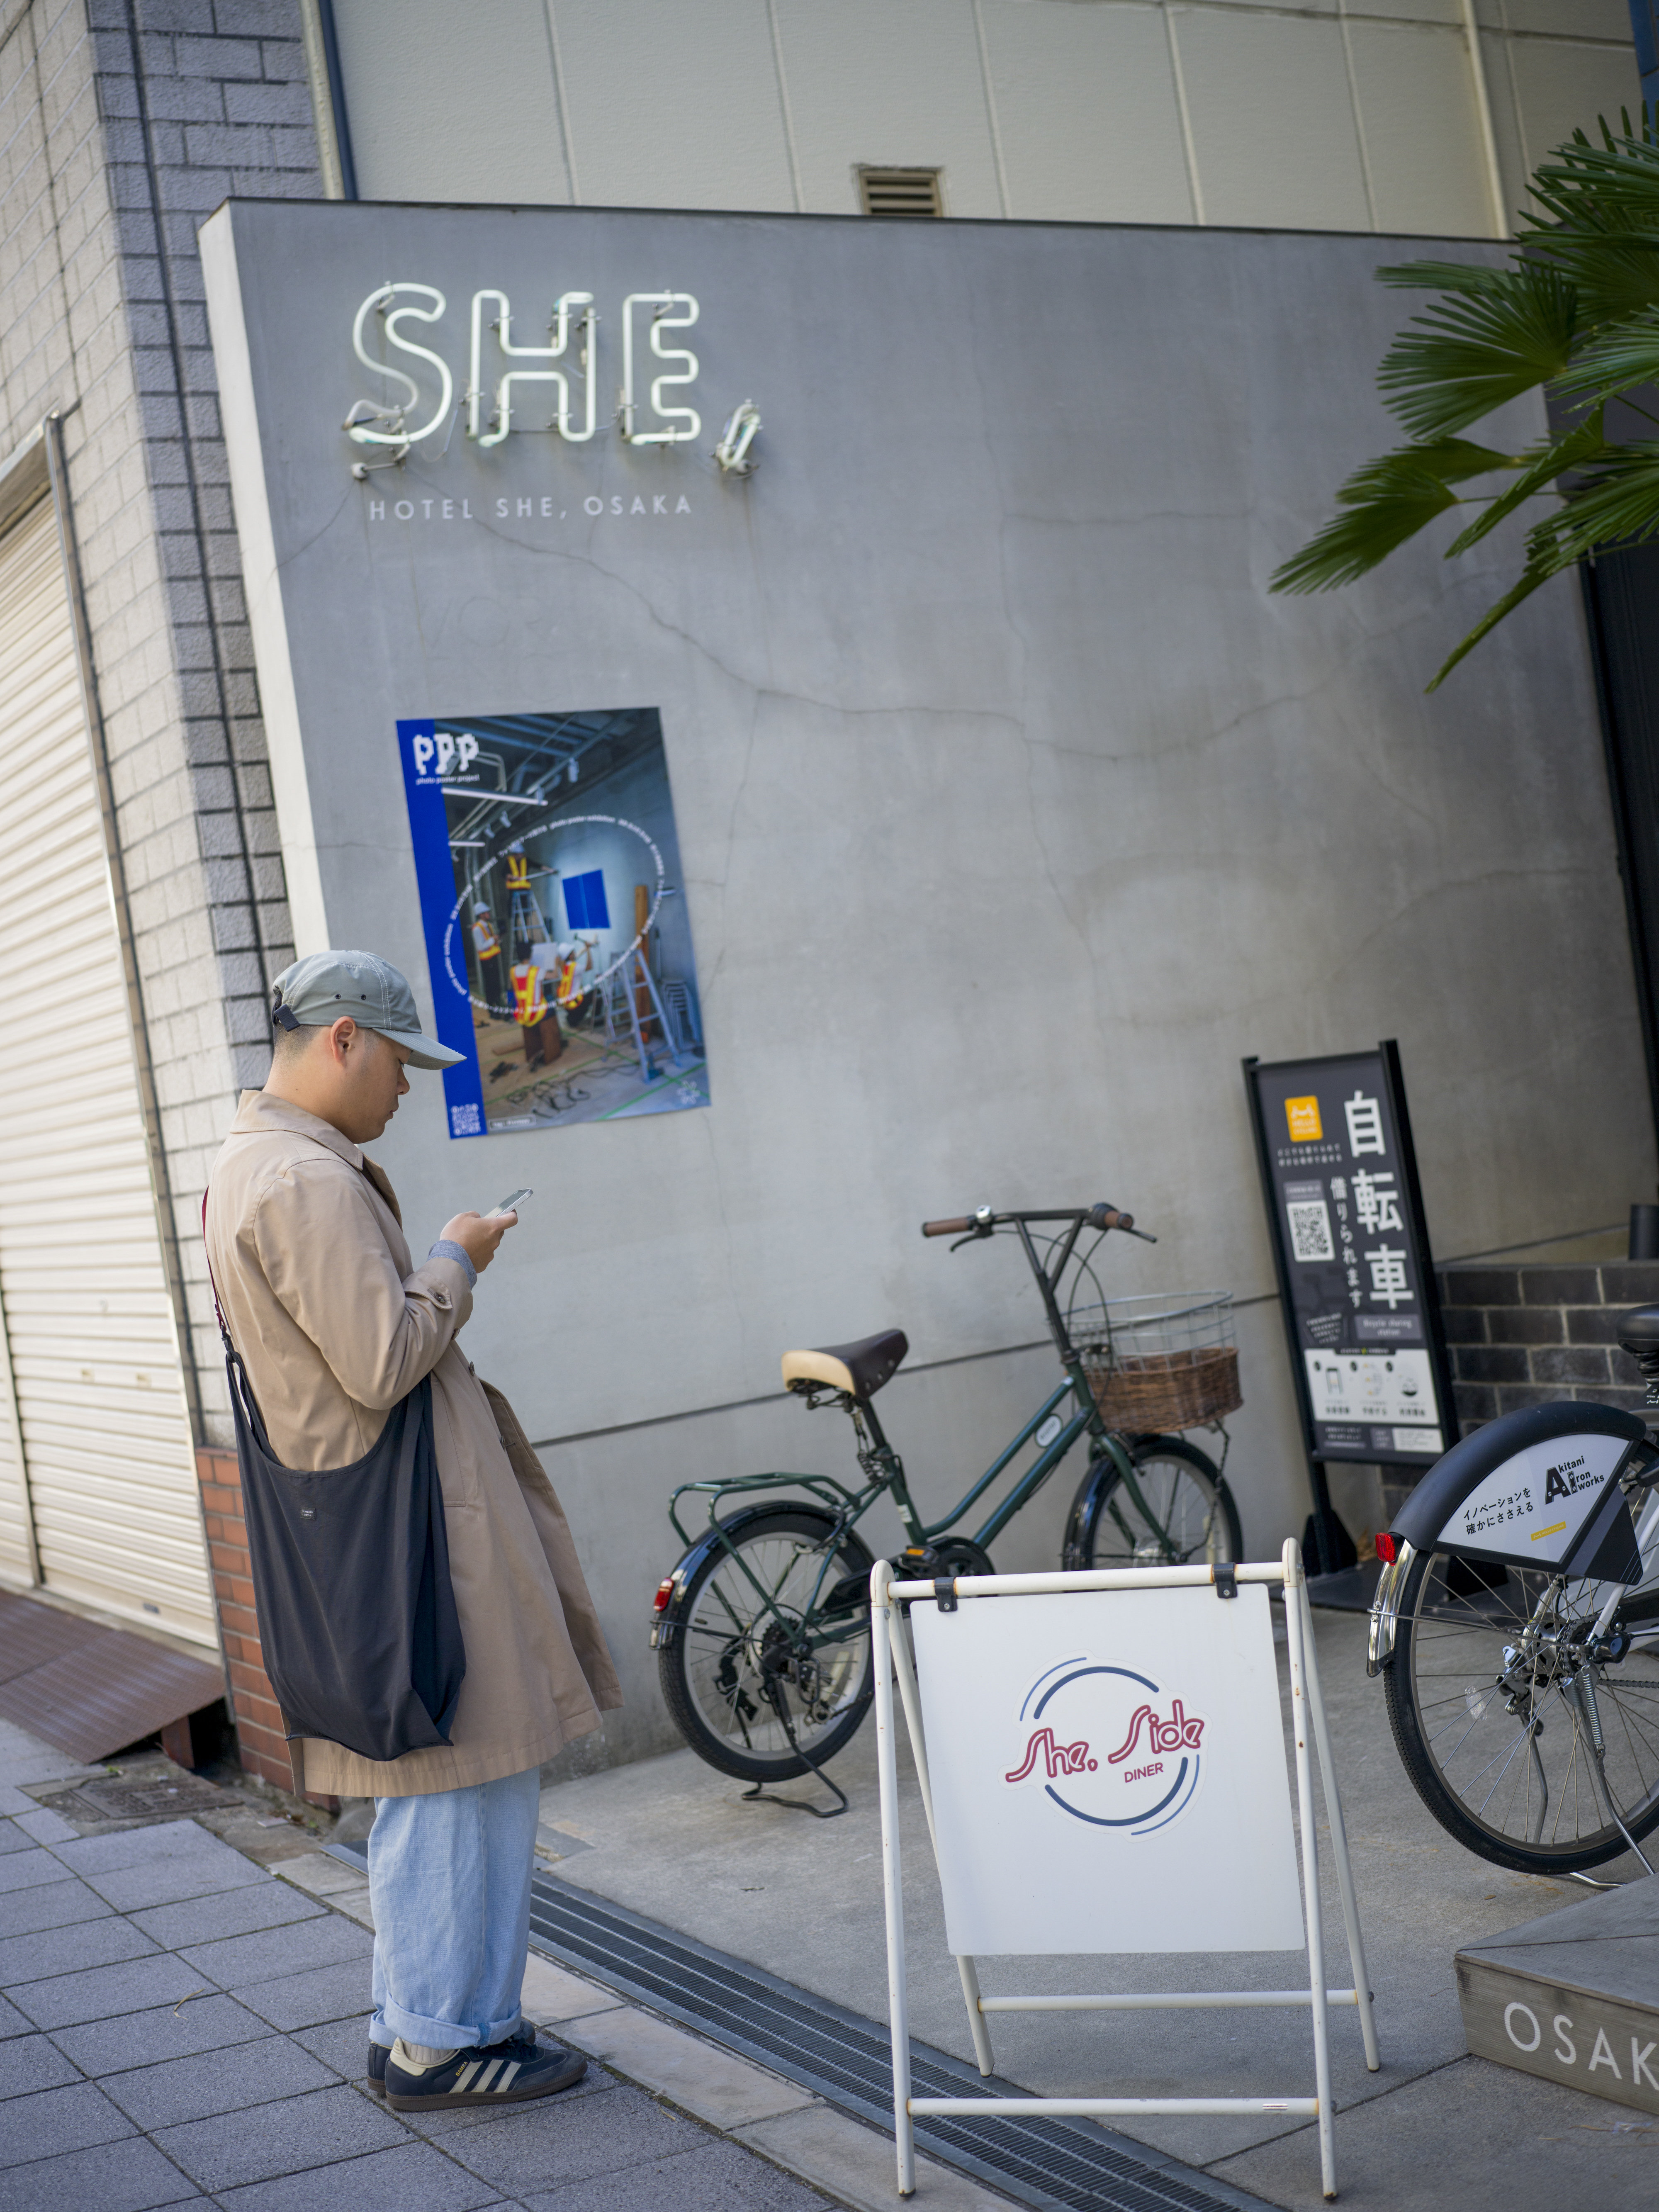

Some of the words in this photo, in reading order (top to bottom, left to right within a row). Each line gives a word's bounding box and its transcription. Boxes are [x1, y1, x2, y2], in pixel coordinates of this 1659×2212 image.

[369, 499, 473, 521] HOTEL
[496, 497, 568, 520] SHE,
[583, 494, 691, 516] OSAKA
[416, 776, 435, 786] photo
[436, 775, 456, 784] poster
[457, 774, 480, 783] project
[1344, 1090, 1415, 1310] 自転車
[1330, 1175, 1363, 1309] 借りられます
[1578, 1475, 1605, 1491] works
[1464, 1487, 1531, 1521] イノベーションを
[1466, 1501, 1533, 1535] 確かにささえる
[1108, 1699, 1205, 1764] Side
[1124, 1762, 1164, 1783] DINER
[455, 2061, 468, 2076] SAMBA
